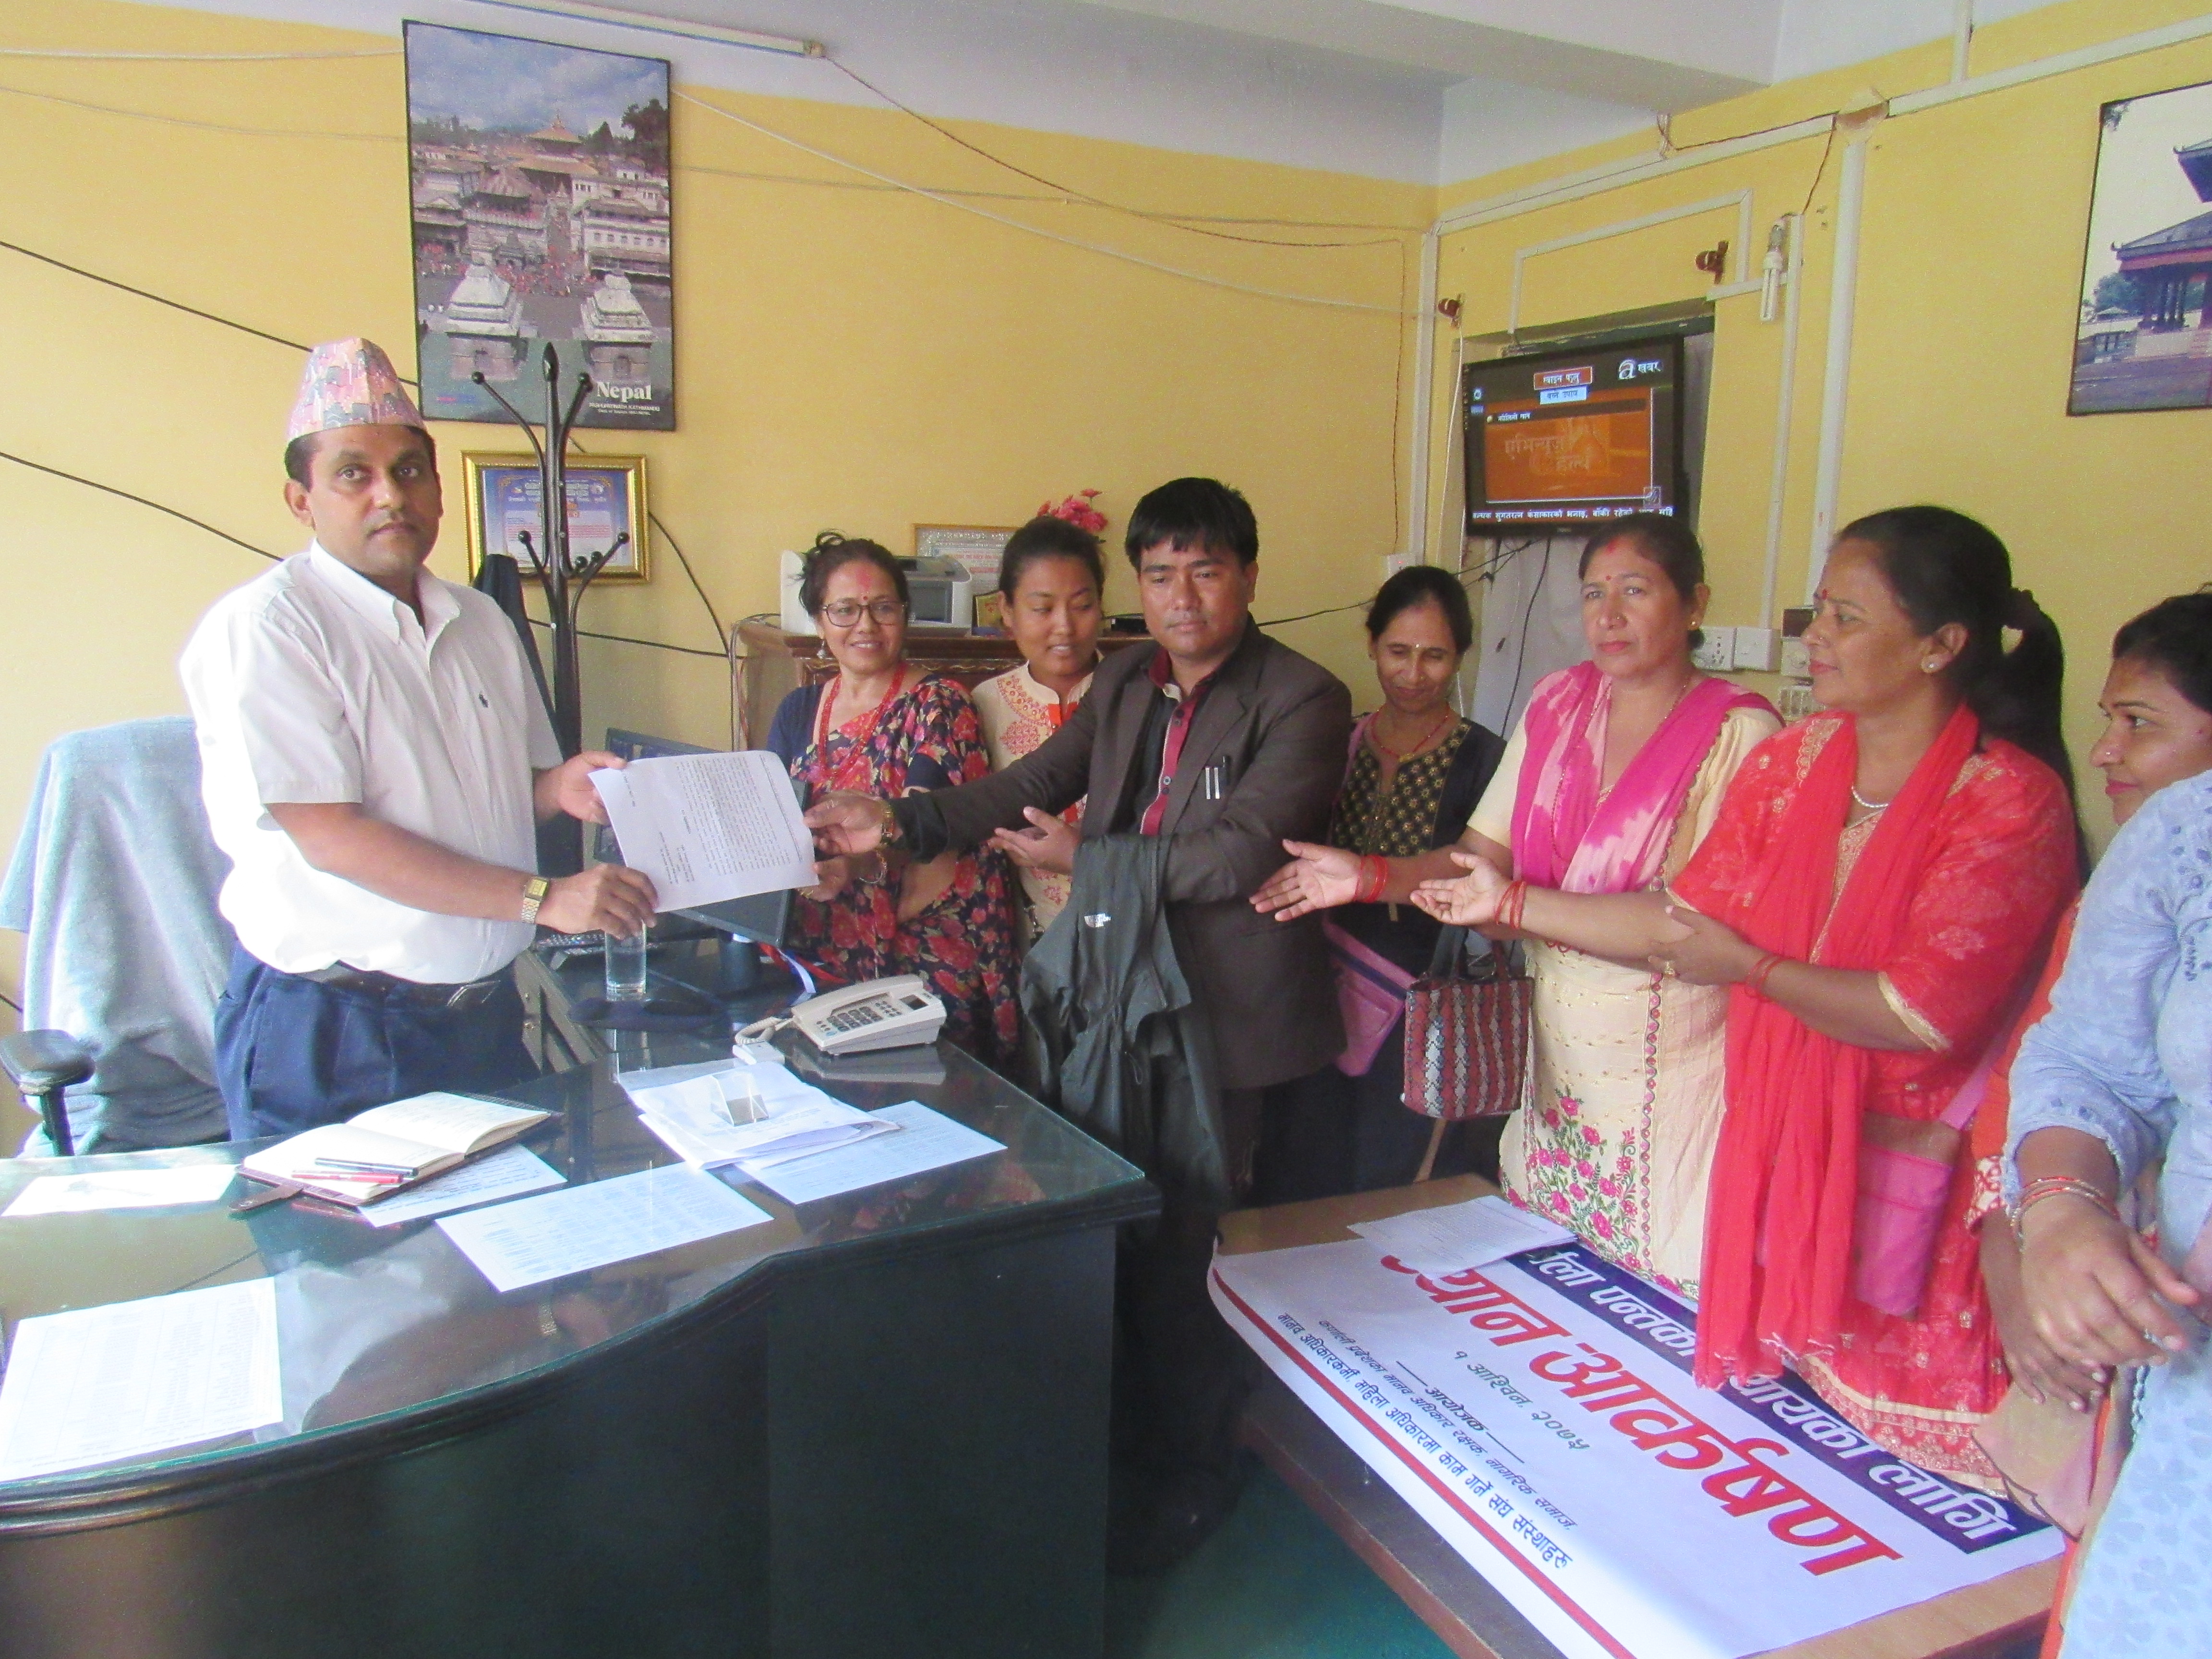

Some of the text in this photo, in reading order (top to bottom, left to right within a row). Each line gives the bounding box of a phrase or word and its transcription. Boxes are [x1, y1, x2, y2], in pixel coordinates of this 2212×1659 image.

[596, 382, 651, 403] Nepal
[1277, 1312, 1305, 1334] मानव
[1355, 1380, 1390, 1408] महिला
[1385, 1407, 1442, 1454] अधिकारमा
[1439, 1451, 1468, 1477] काम
[1466, 1473, 1493, 1497] गर्ने
[1489, 1493, 1514, 1517] संघ
[1383, 1373, 1415, 1394] मानव
[1410, 1396, 1455, 1428] अधिकार
[1486, 1458, 1538, 1495] नागरिक
[1425, 1386, 1490, 1431] आयोजक
[1455, 1350, 1468, 1359] १
[1531, 1411, 1590, 1449] २०७५
[1529, 1342, 1903, 1576] आकर्षण
[1868, 1459, 2017, 1539] लागि
